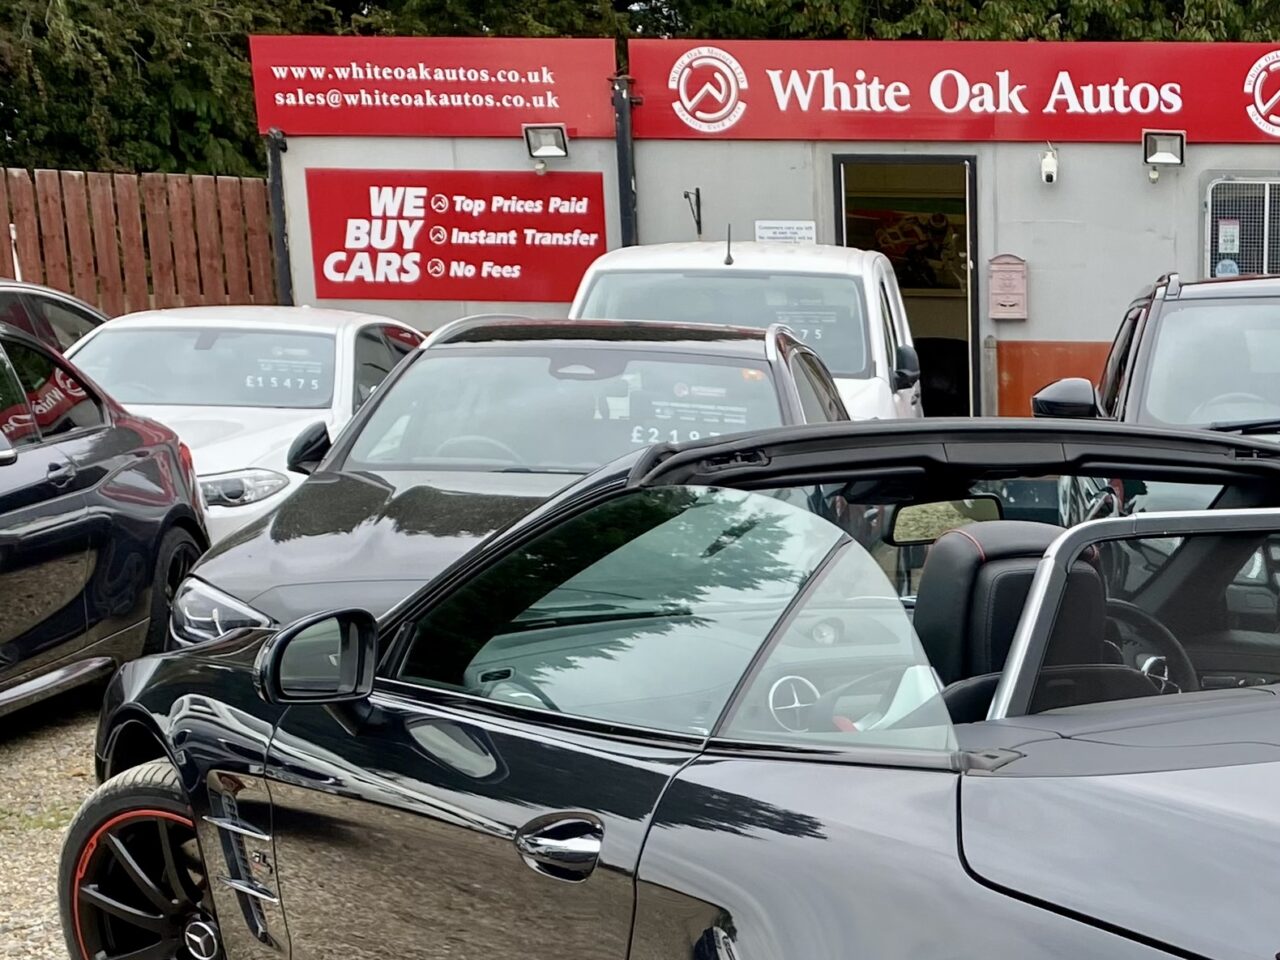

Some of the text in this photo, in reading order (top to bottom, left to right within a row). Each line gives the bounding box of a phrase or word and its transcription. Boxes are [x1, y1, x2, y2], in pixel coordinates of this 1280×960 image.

[271, 63, 555, 84] www.whiteoakautos.co.uk
[275, 89, 559, 108] sales@whiteoakautos.co.uk
[766, 68, 1182, 114] White Oak Autos
[370, 187, 427, 217] WE
[453, 196, 588, 216] Top Prices Paid
[345, 218, 424, 250] BUY
[451, 228, 598, 245] Instant Transfer
[323, 251, 421, 283] CARS
[450, 262, 520, 278] No Fees
[245, 375, 319, 390] £15475
